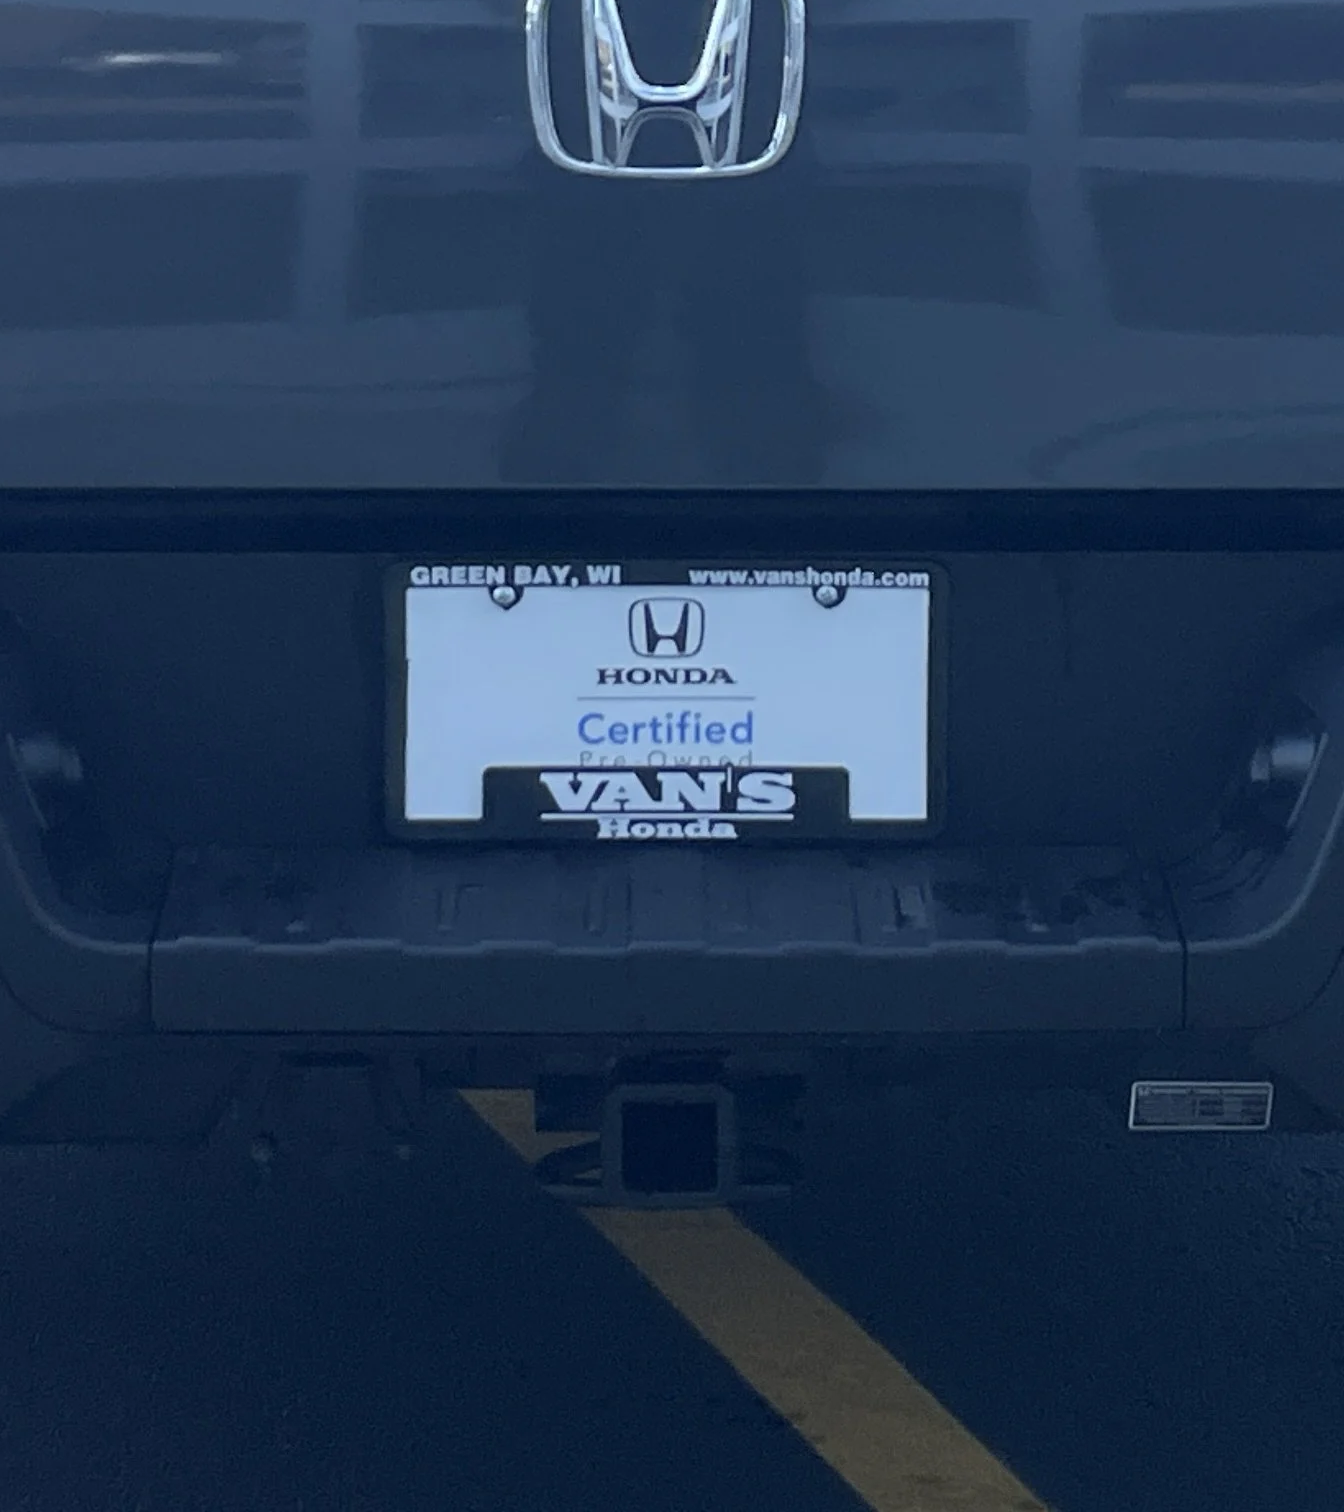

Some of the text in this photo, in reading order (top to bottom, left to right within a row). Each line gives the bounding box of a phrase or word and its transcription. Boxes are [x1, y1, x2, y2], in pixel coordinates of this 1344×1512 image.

[410, 564, 622, 589] GREEN BAY, WI
[688, 566, 931, 587] www.vanshonda.com
[596, 667, 735, 686] HONDA
[577, 709, 754, 746] Certified
[539, 763, 797, 813] VAN'S
[596, 819, 739, 840] Honda
